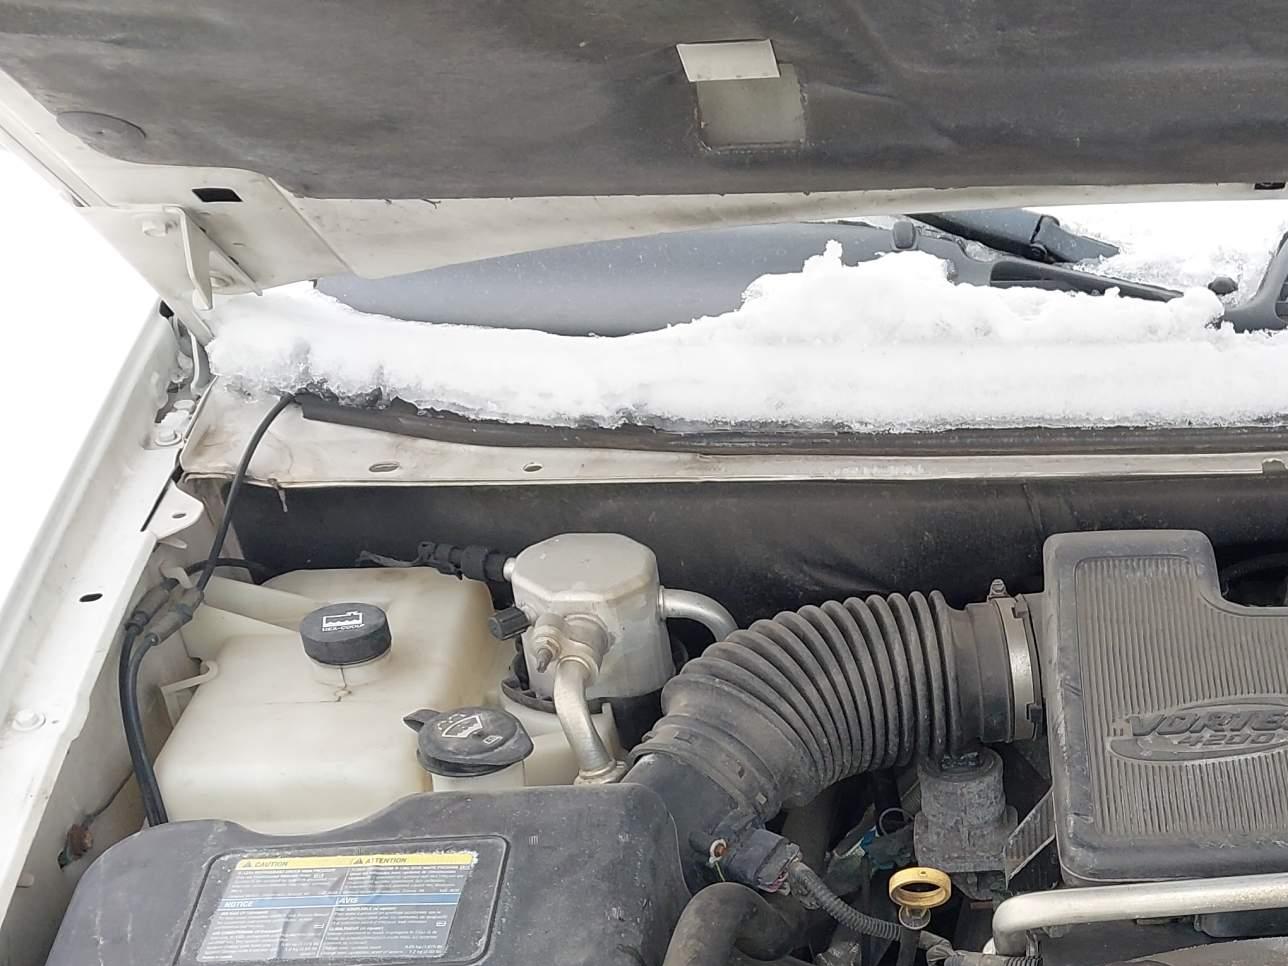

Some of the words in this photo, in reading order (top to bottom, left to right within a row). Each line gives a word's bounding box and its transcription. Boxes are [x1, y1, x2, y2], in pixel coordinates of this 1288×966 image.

[1177, 733, 1276, 747] 4200
[254, 860, 289, 868] CAUTION
[364, 856, 408, 866] ATTENTION
[224, 900, 254, 909] NOTICE
